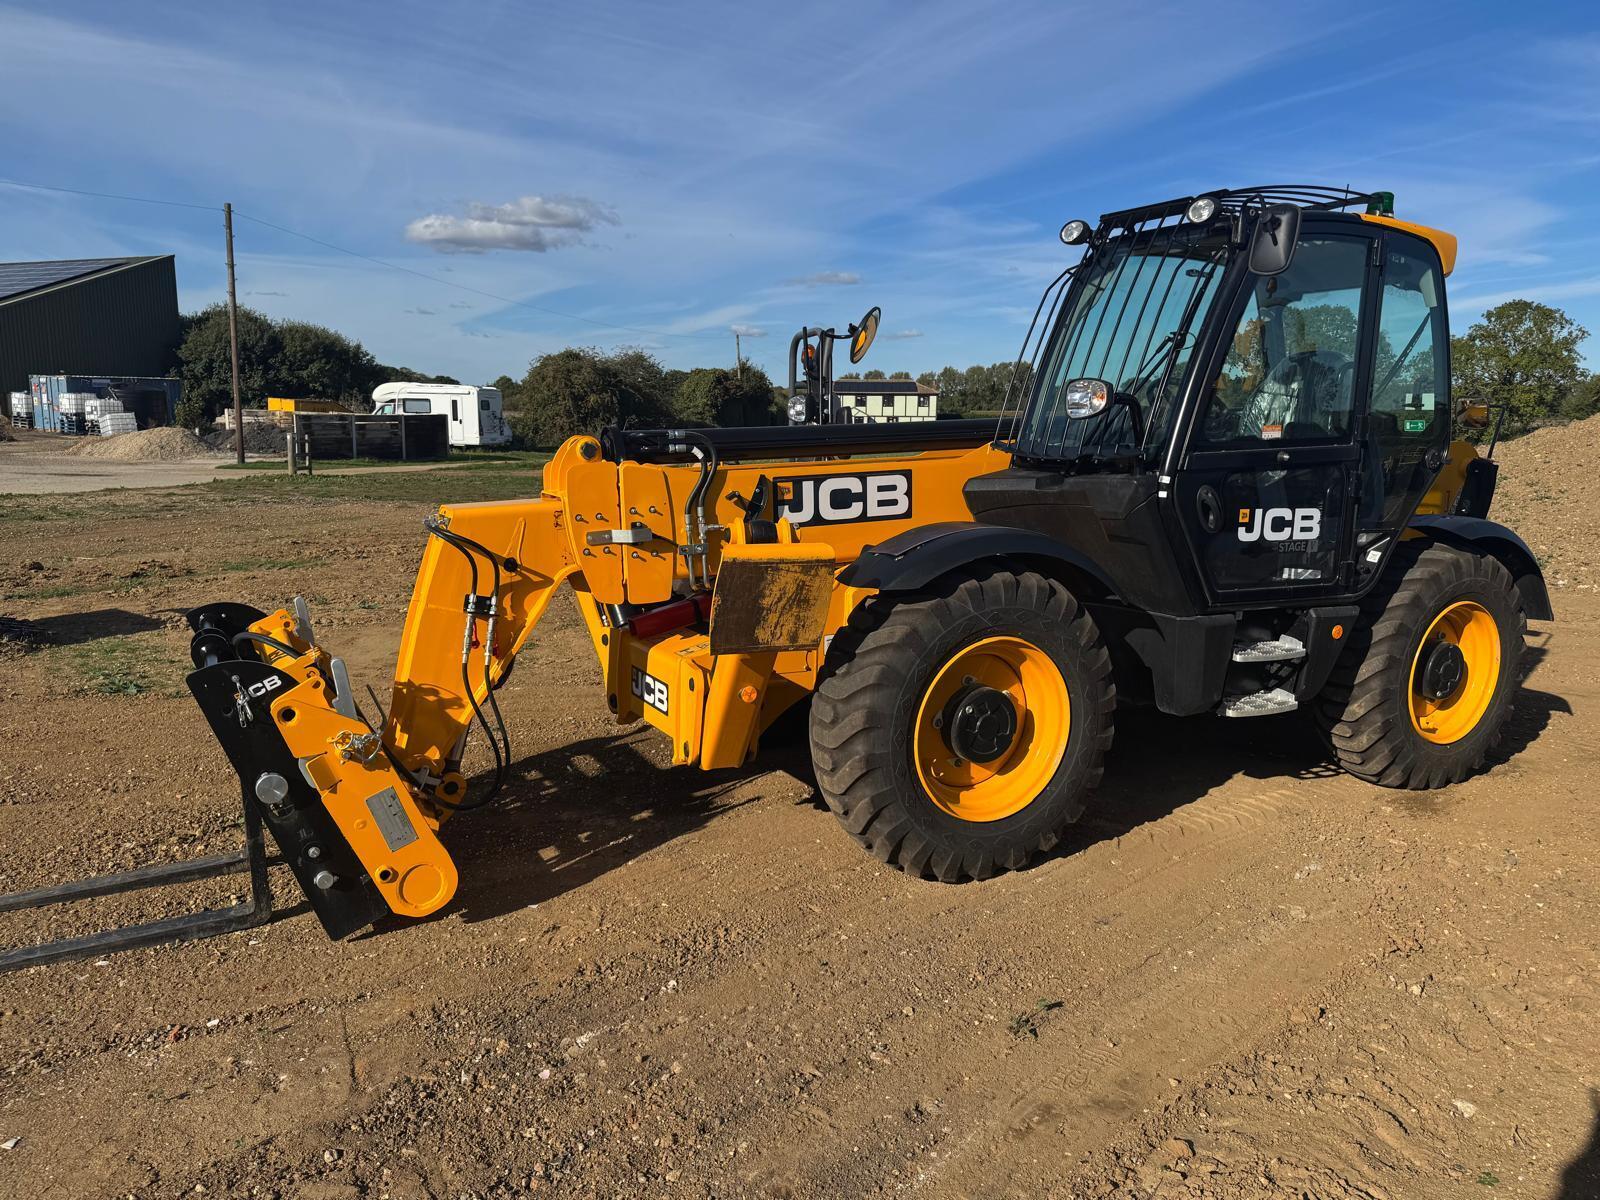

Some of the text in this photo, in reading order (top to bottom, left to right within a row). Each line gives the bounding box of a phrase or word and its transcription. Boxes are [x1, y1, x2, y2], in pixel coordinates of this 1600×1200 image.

[778, 475, 909, 523] JCB
[1238, 508, 1321, 541] JCB
[1279, 541, 1306, 553] STAGE
[238, 675, 282, 700] CB
[633, 669, 668, 712] JCB
